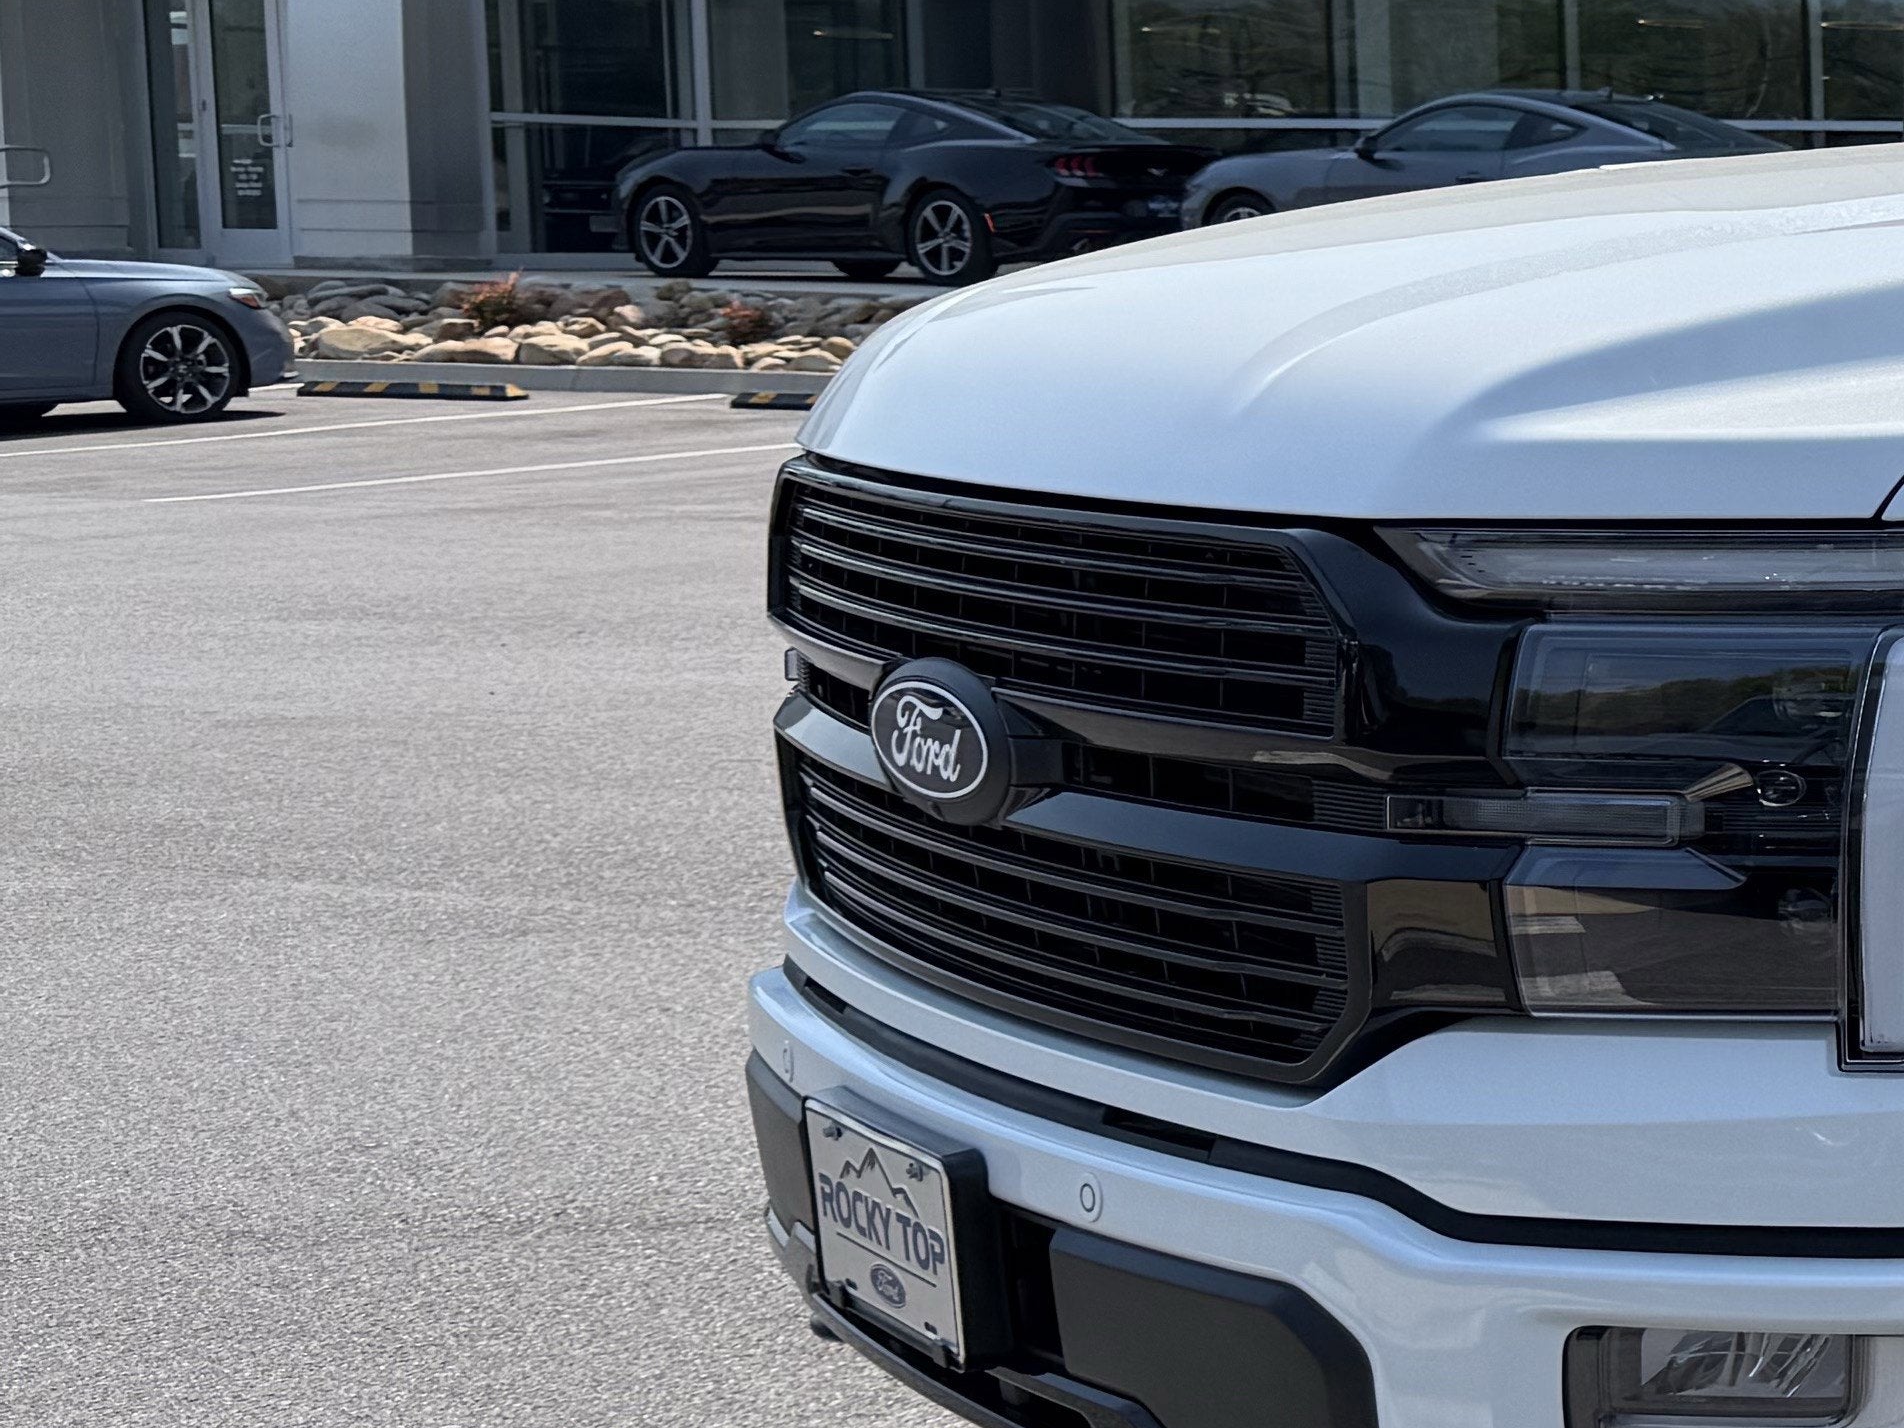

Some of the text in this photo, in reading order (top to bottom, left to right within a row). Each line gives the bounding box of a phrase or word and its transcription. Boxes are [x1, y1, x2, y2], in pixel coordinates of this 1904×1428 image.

[891, 694, 962, 783] Ford
[818, 1172, 946, 1277] ROCKY TOP
